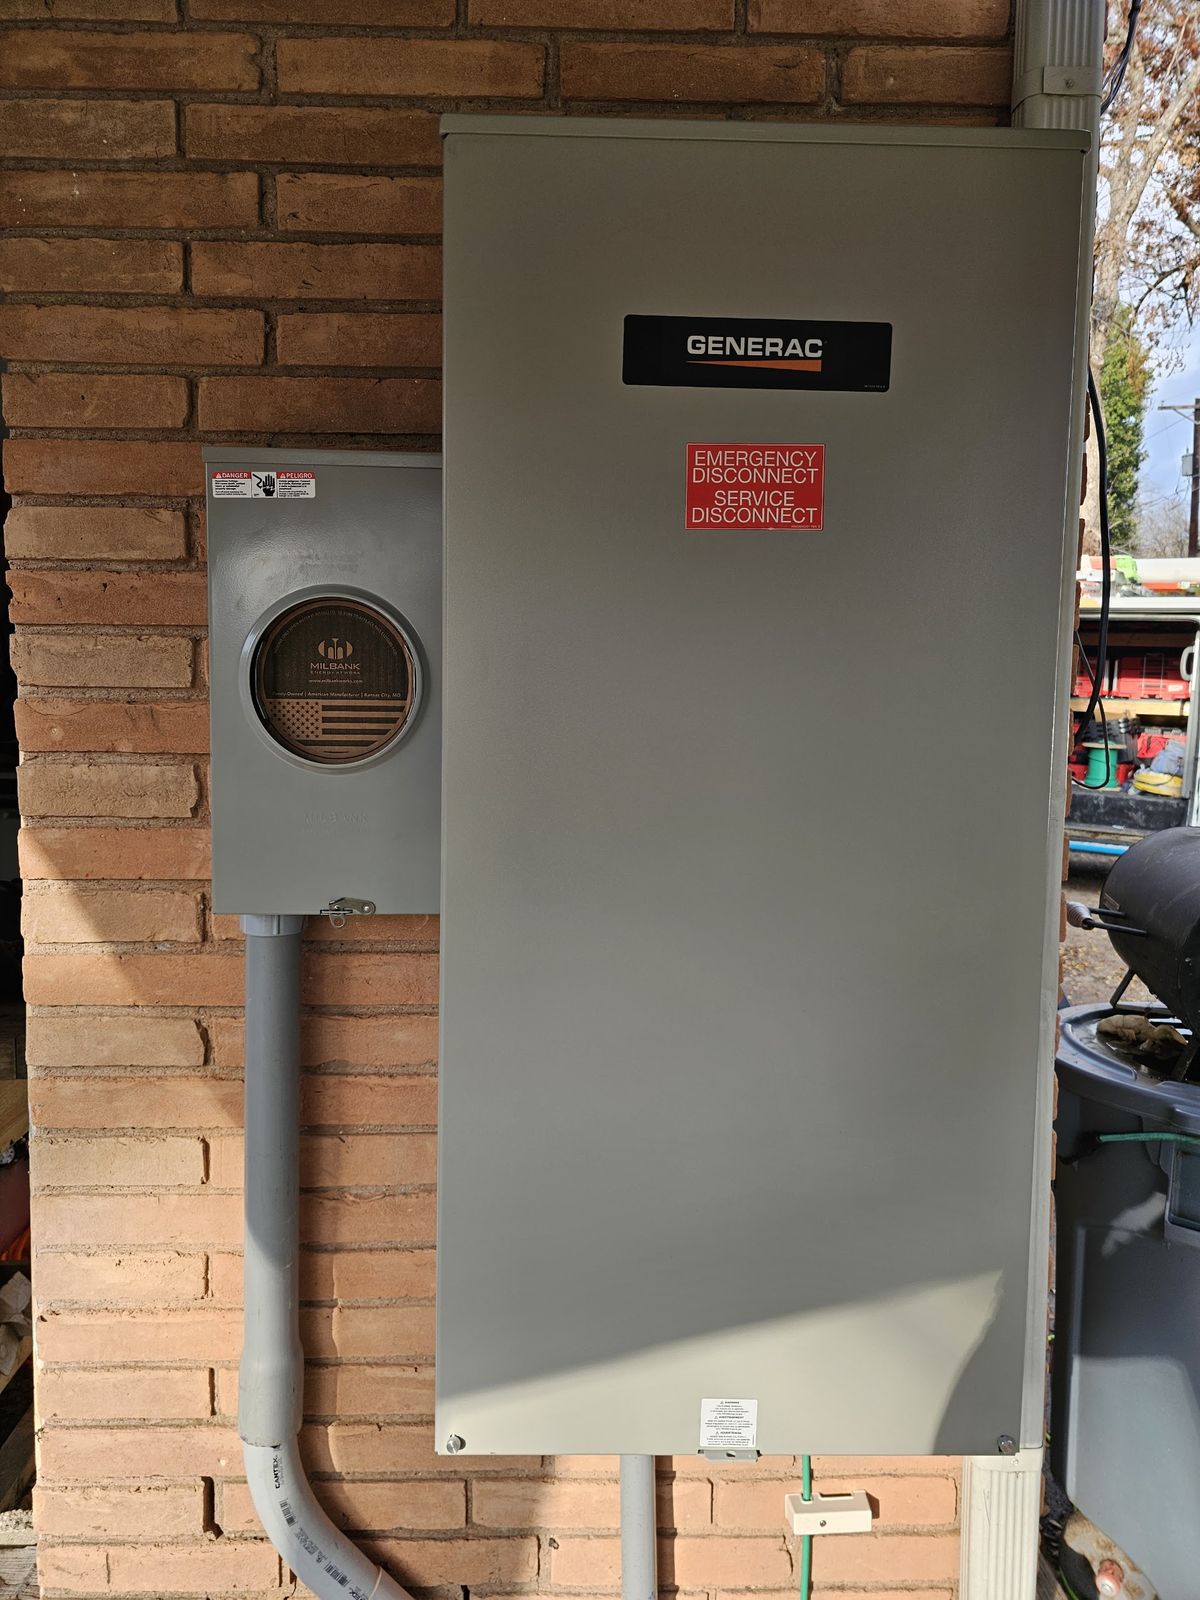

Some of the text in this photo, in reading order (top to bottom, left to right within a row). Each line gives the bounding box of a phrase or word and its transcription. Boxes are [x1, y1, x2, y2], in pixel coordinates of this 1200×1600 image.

[687, 335, 823, 358] GENERAC
[695, 450, 817, 467] EMERGENCY
[692, 467, 819, 484] DISCONNECT
[714, 490, 795, 507] SERVICE
[692, 507, 818, 523] DISCONNECT
[310, 662, 361, 670] MILBANK
